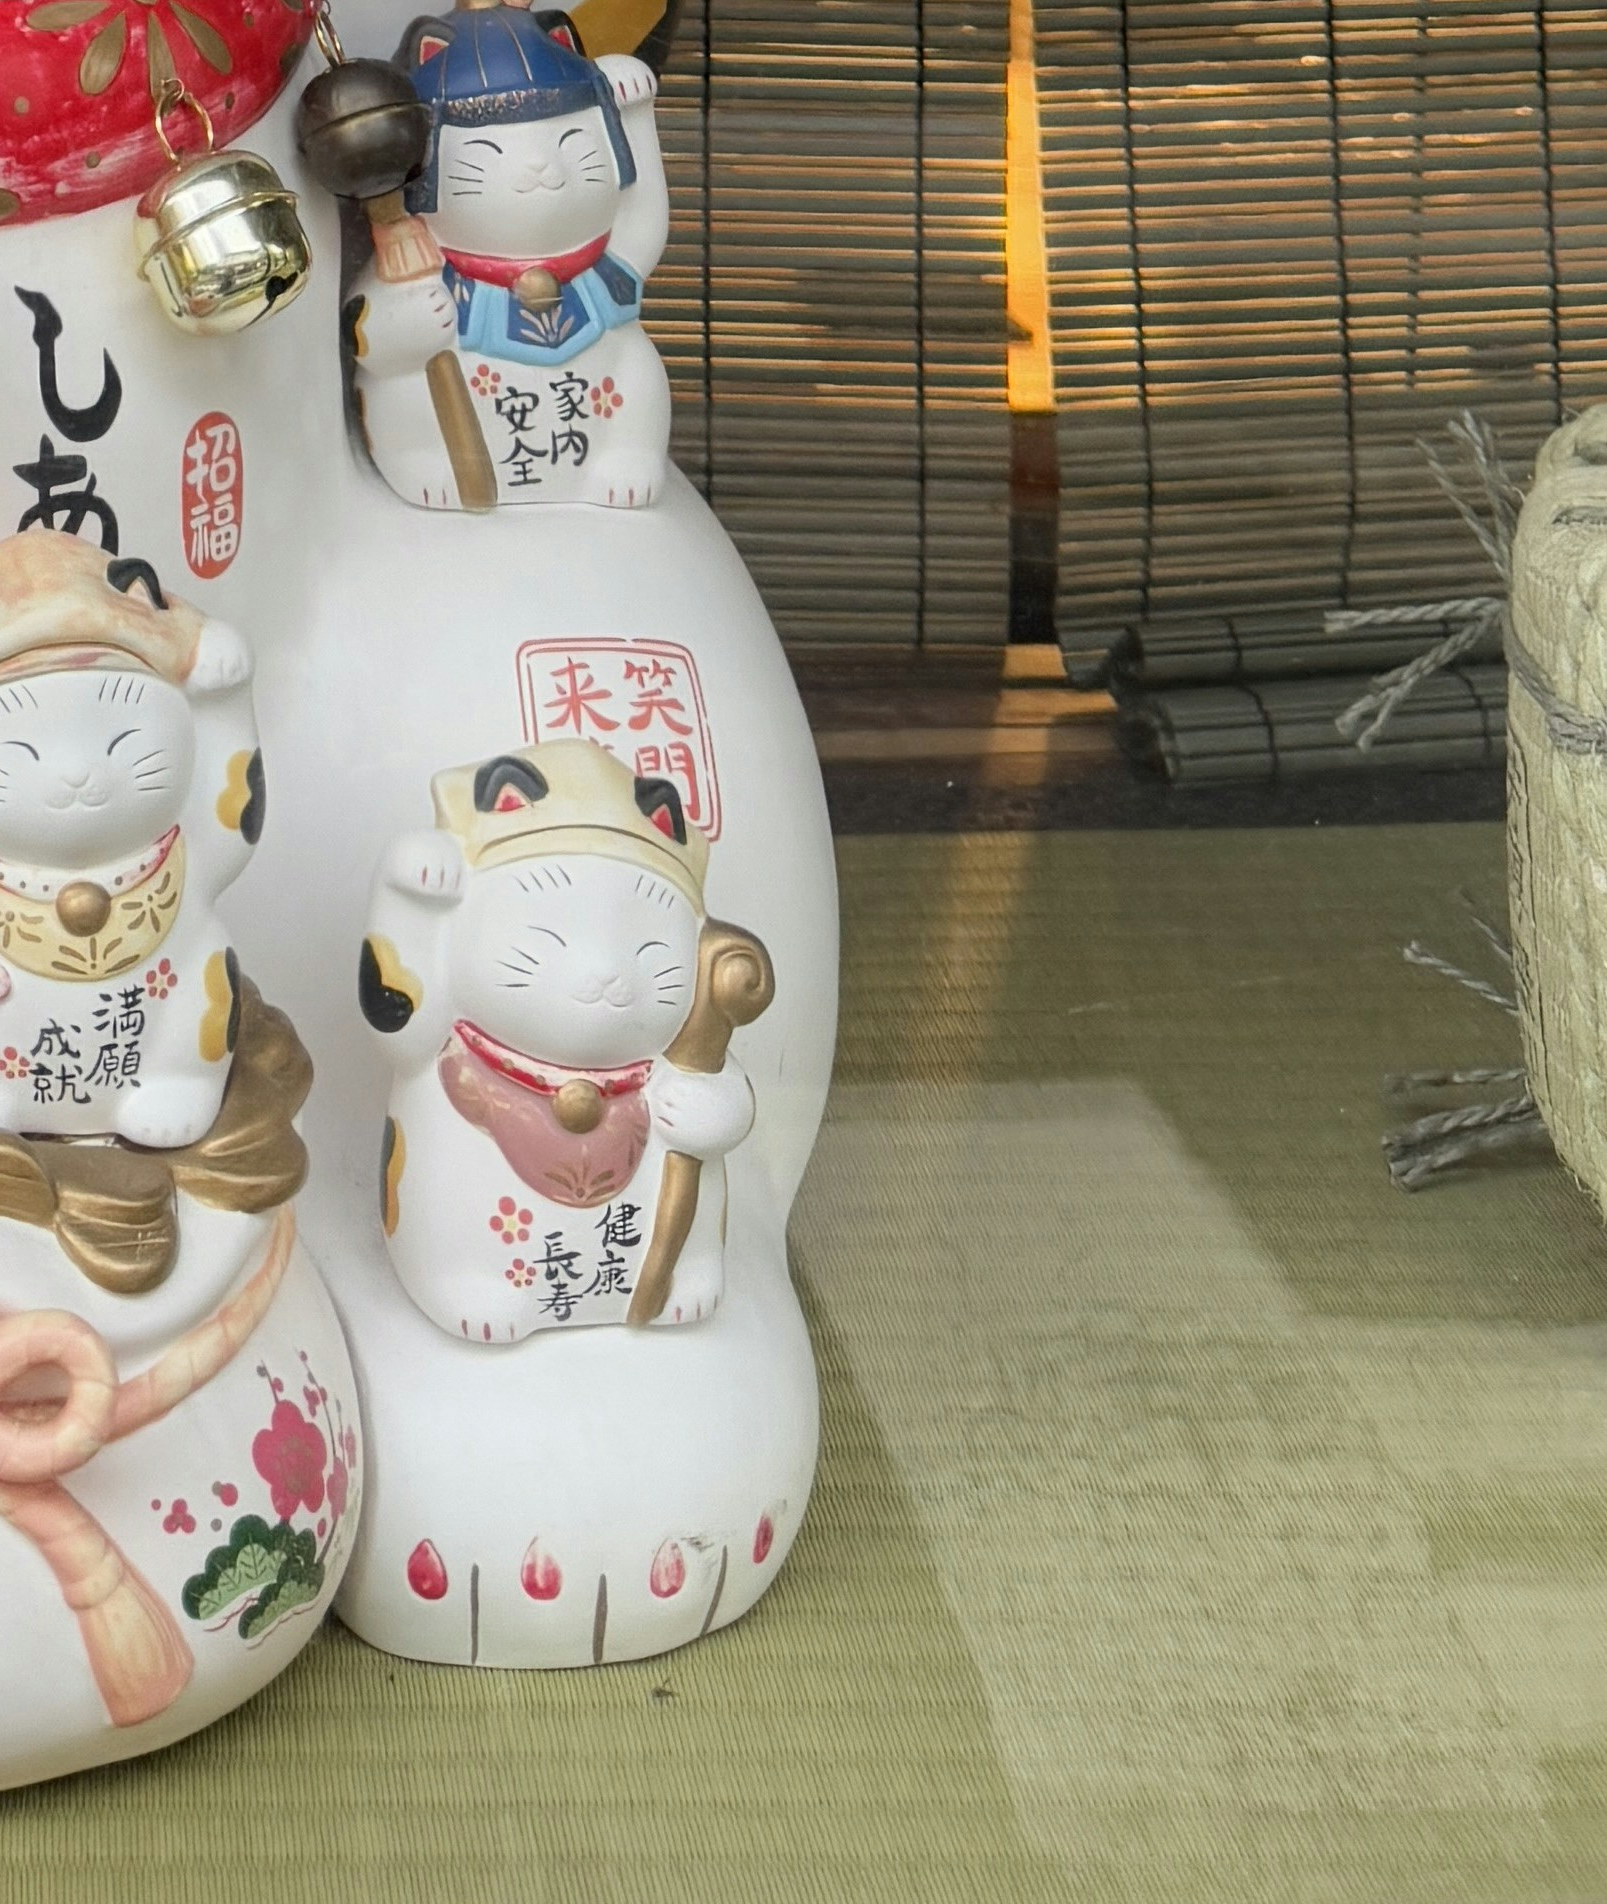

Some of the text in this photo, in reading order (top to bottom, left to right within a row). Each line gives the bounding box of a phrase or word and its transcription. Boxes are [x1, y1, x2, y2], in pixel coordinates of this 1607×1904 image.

[494, 386, 549, 486] 安全
[549, 372, 589, 466] 家内
[185, 421, 242, 568] 招福
[544, 655, 620, 752] 来
[623, 659, 701, 821] 笑門
[28, 1018, 91, 1104] 成就
[83, 984, 145, 1089] 満願
[533, 1231, 583, 1322] 長寿
[583, 1202, 642, 1295] 健康
